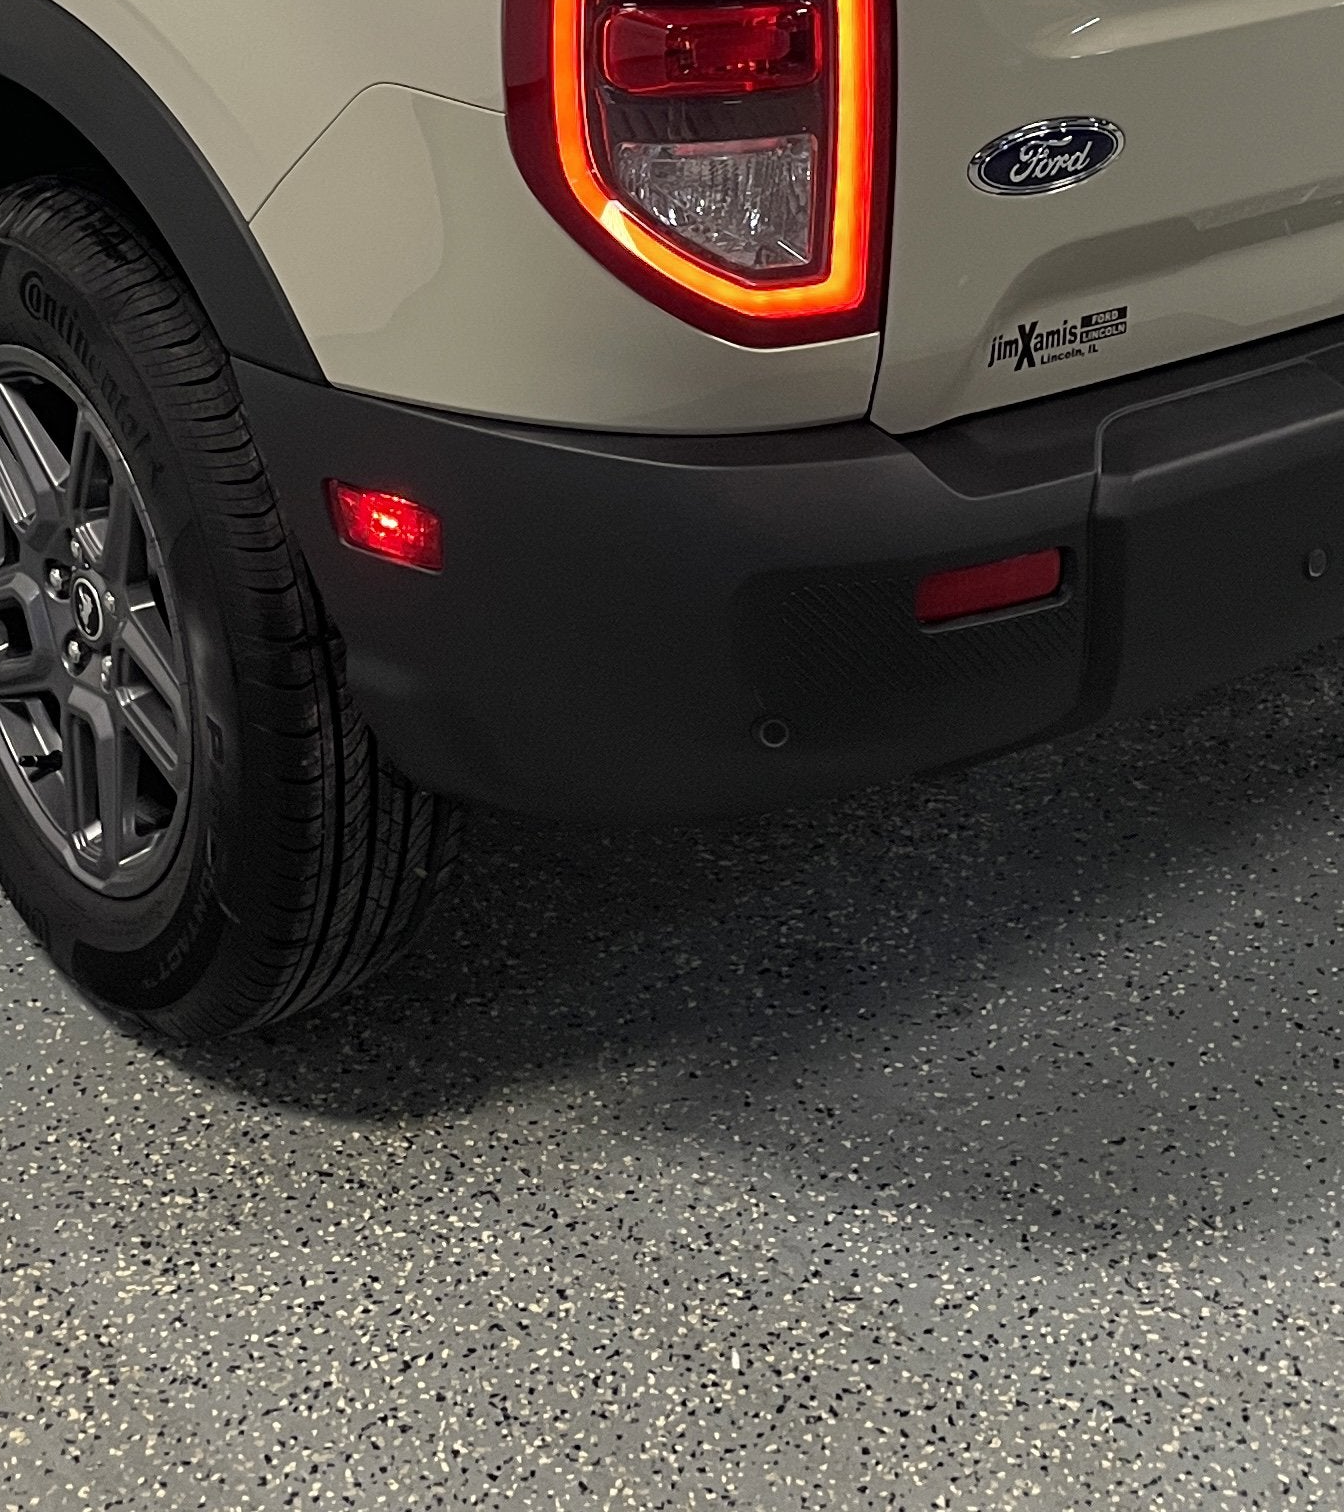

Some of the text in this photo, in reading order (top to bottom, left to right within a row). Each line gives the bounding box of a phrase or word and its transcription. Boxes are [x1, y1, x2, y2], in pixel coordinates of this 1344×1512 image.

[1009, 135, 1093, 183] Ford
[1091, 310, 1119, 325] FORD
[1088, 344, 1099, 355] IL
